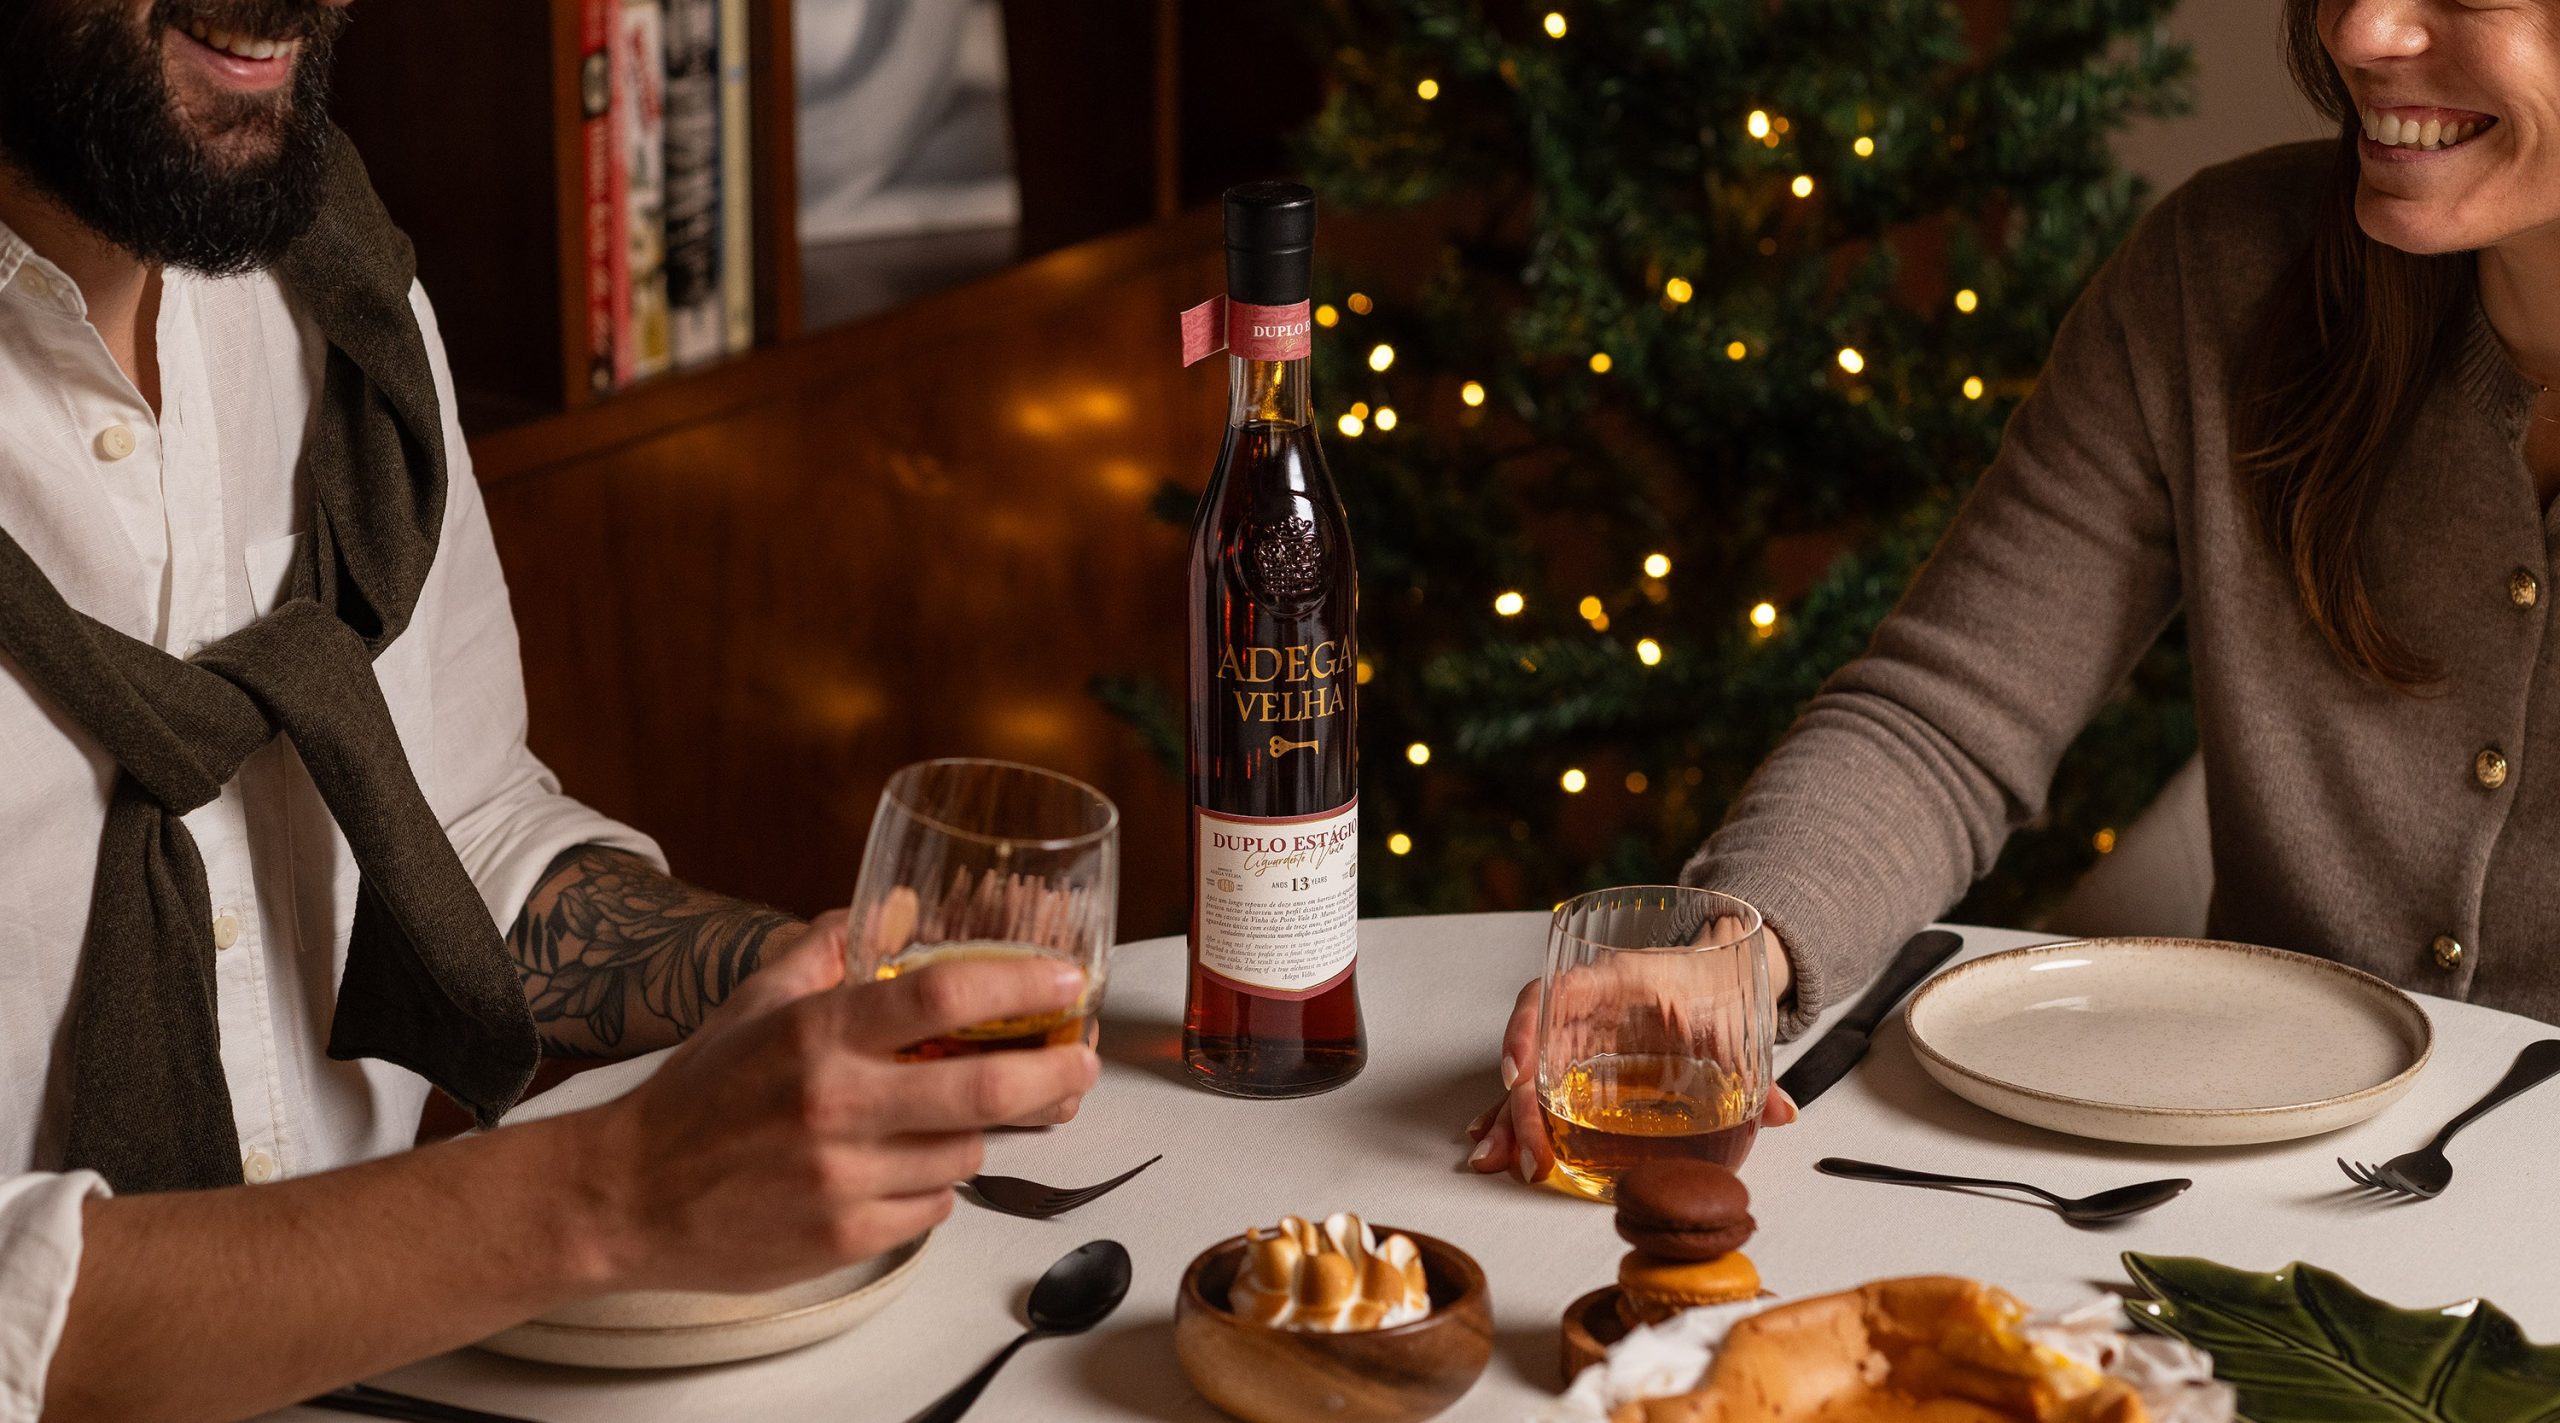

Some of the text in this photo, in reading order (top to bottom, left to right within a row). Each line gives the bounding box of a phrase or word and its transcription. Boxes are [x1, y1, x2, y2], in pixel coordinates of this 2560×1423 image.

[1254, 322, 1303, 338] DUPLO
[1216, 635, 1353, 682] ADEGA
[1233, 683, 1344, 722] VELHA
[1213, 817, 1357, 853] DUPLO ESTÁGIO
[1271, 876, 1328, 892] ANOS 13 YEARS
